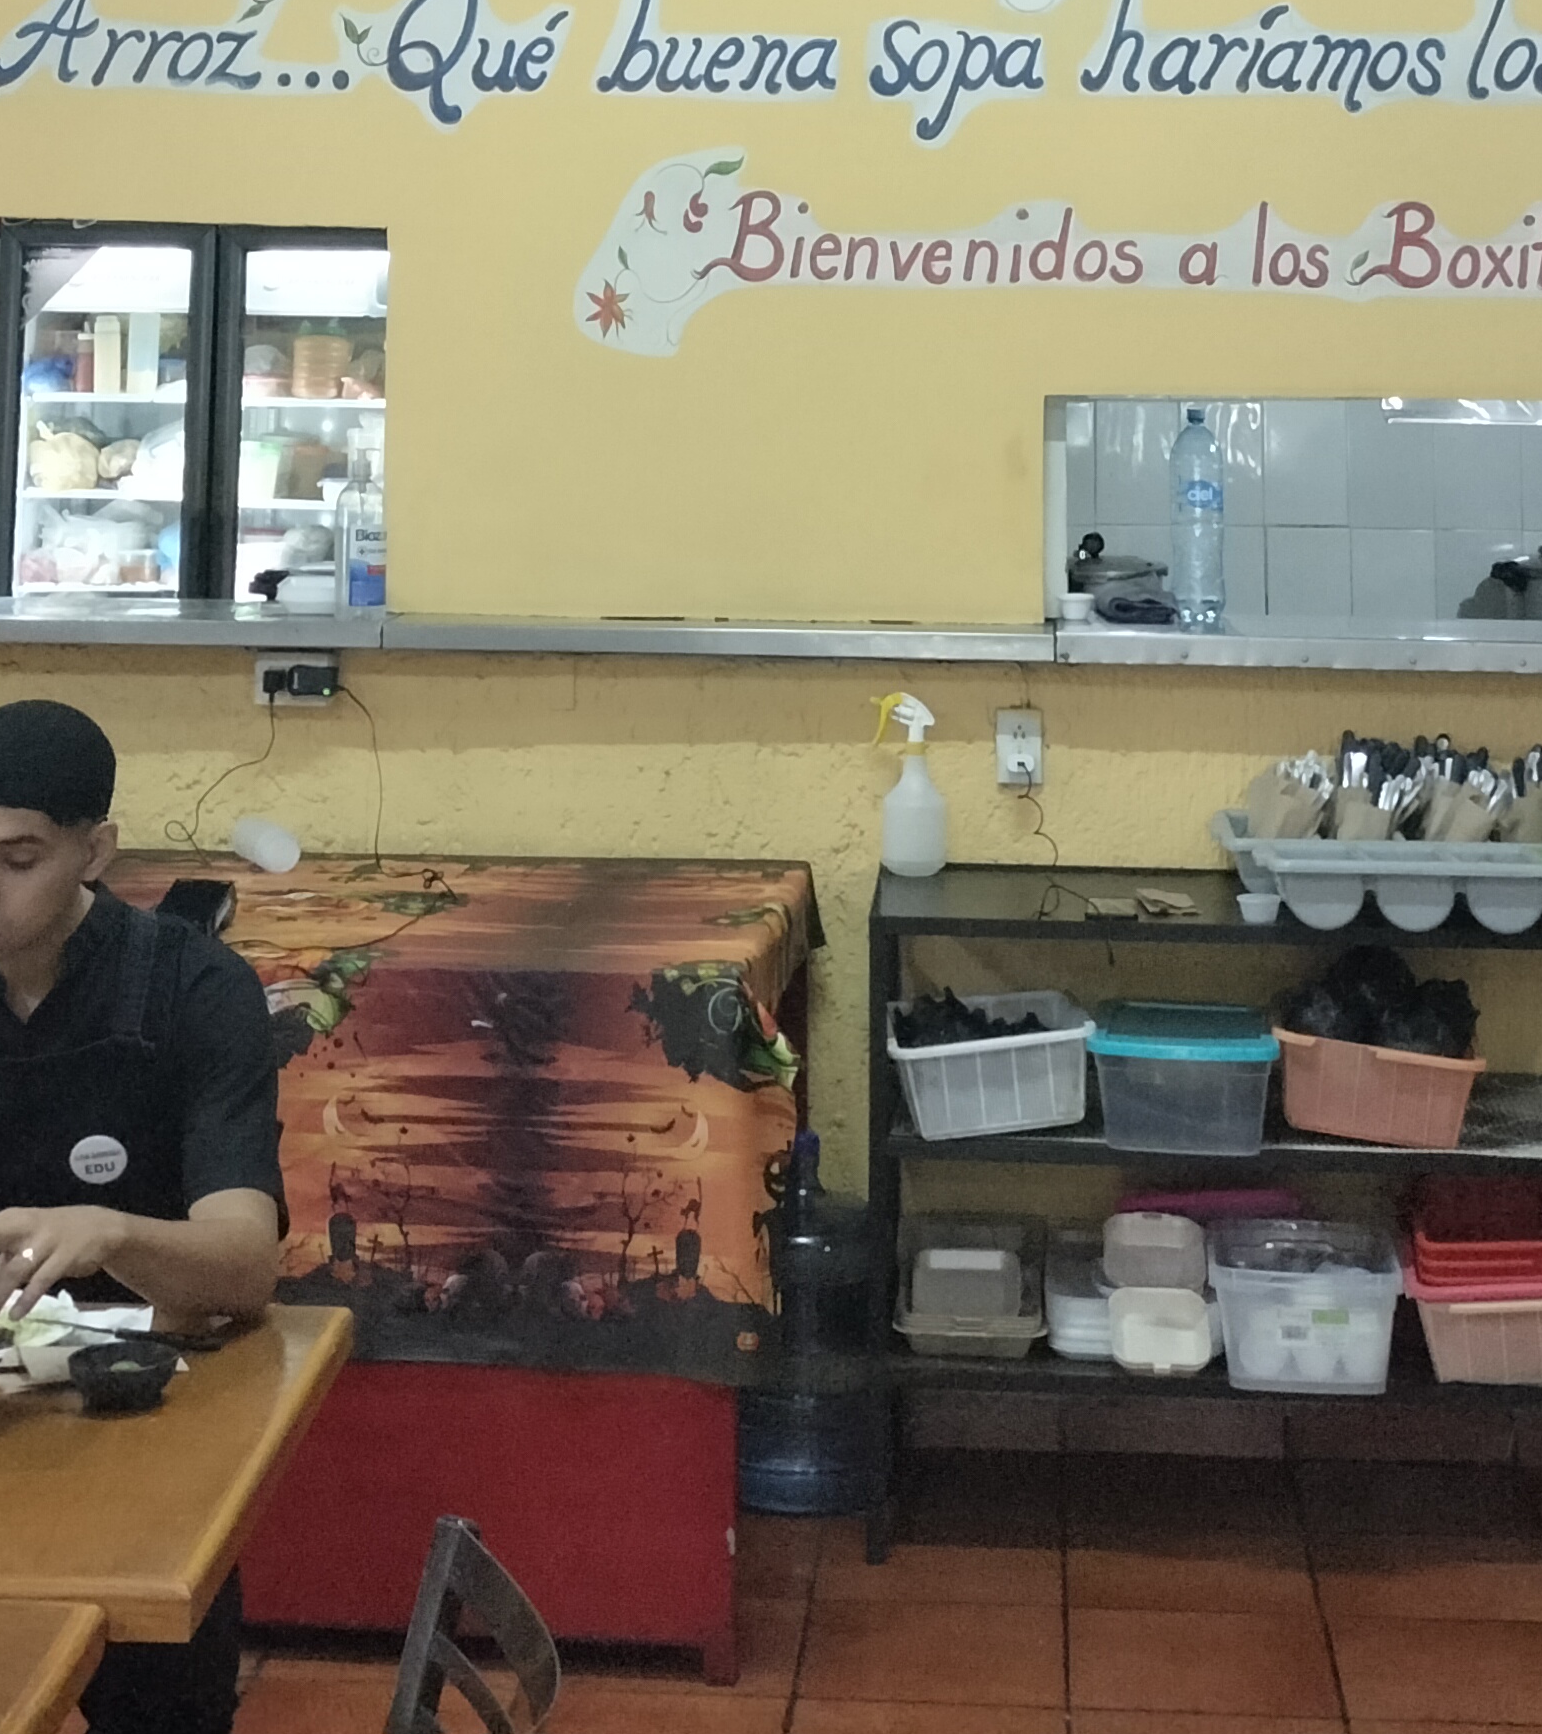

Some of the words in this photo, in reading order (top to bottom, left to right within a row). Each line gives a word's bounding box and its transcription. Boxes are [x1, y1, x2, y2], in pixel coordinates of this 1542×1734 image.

[869, 19, 1043, 139] sopa
[727, 189, 1144, 287] Bienvenidos
[1177, 240, 1222, 288] a
[1252, 201, 1329, 288] los
[84, 1160, 116, 1175] EDU
